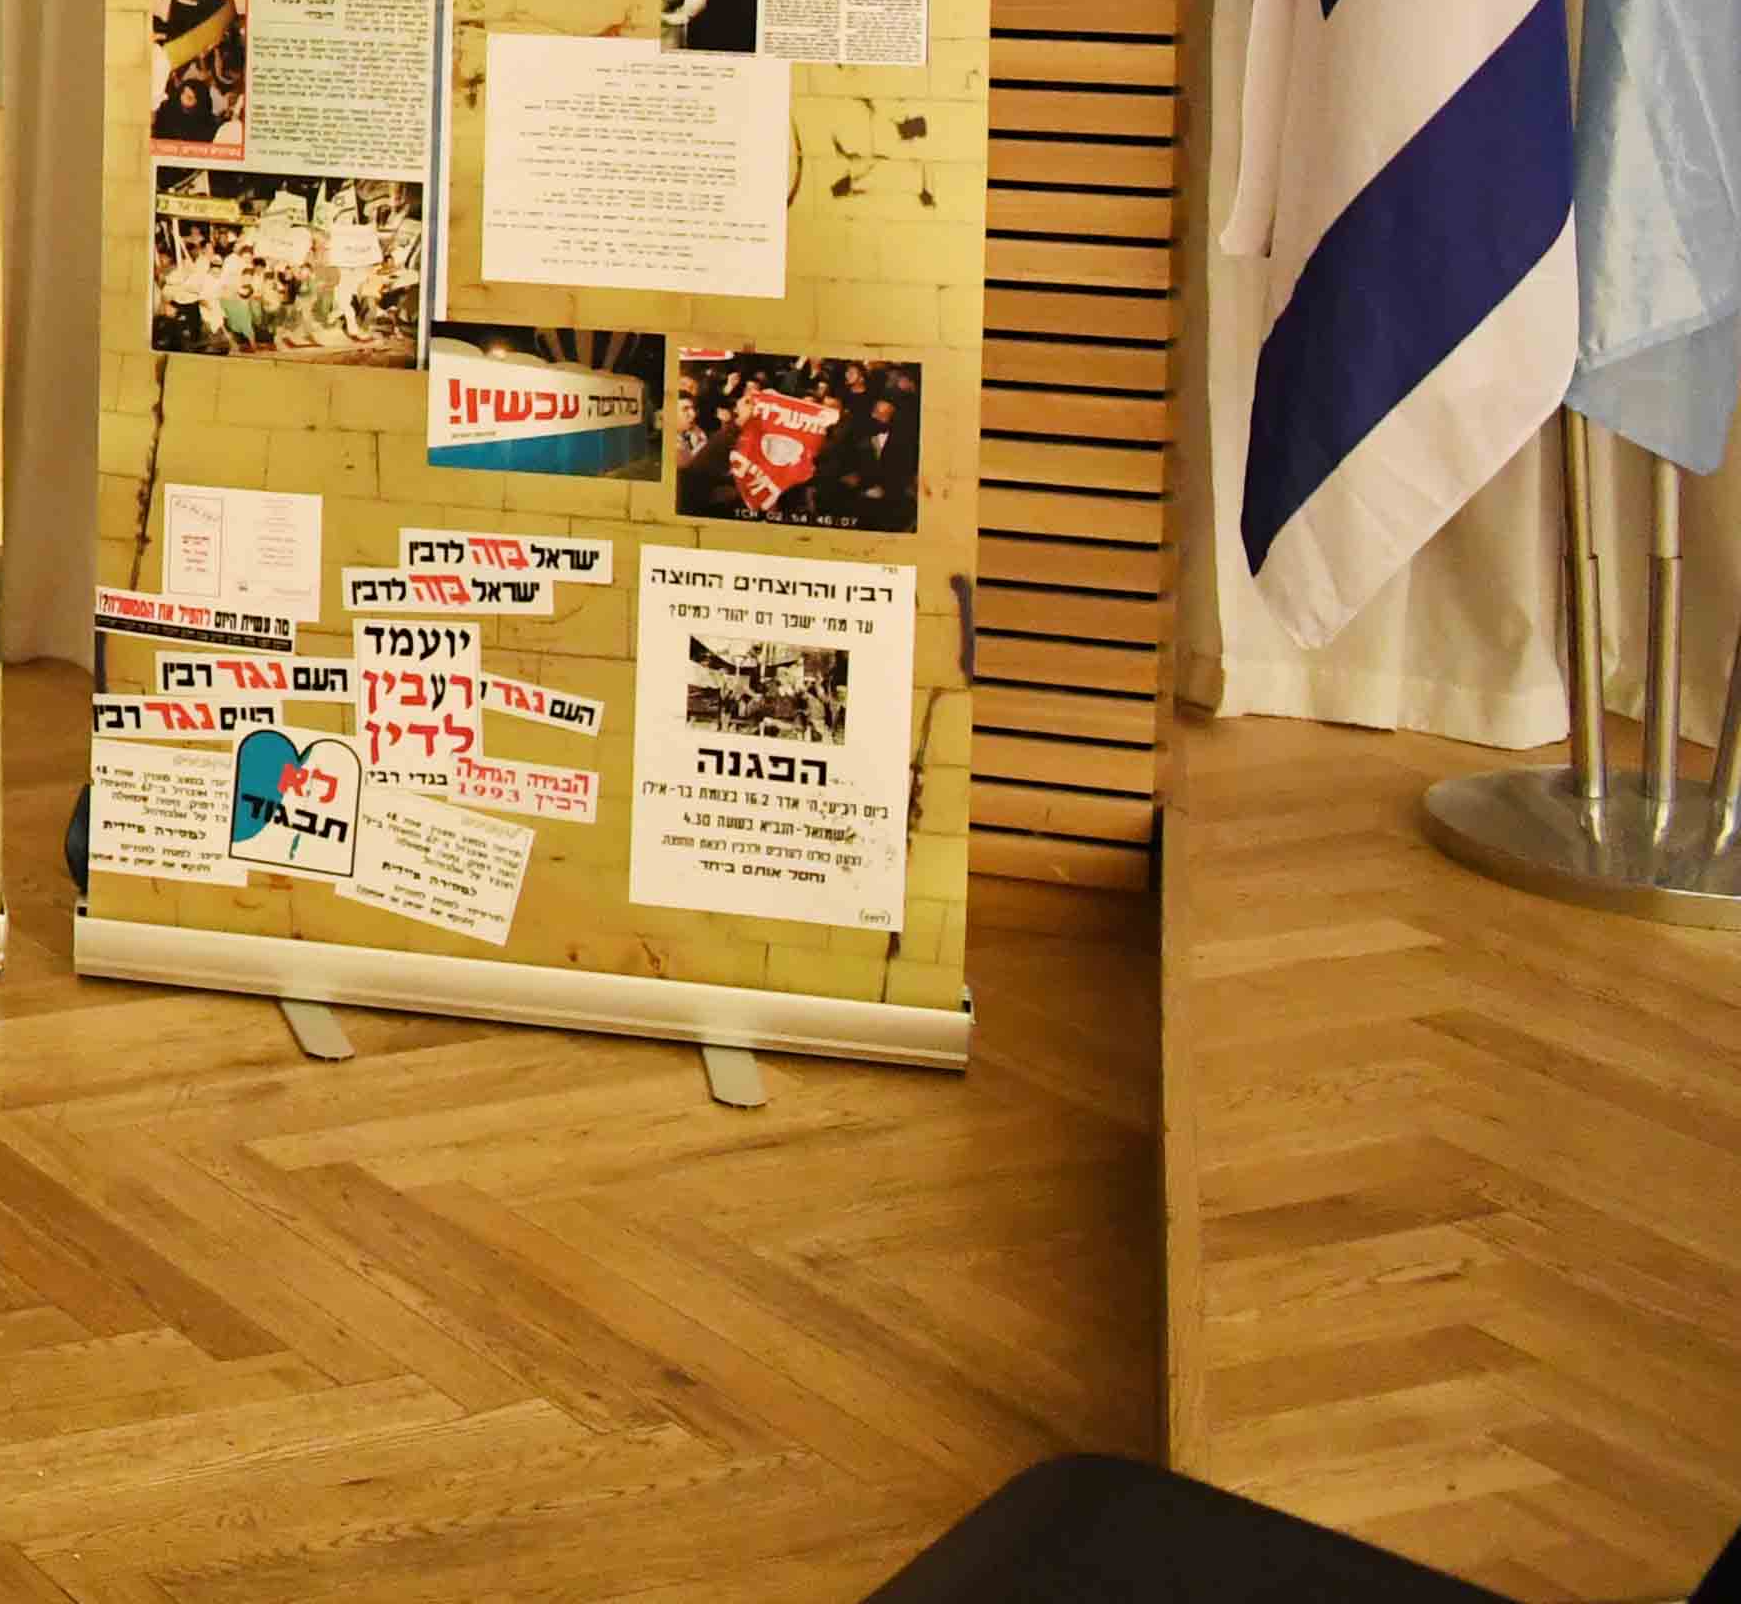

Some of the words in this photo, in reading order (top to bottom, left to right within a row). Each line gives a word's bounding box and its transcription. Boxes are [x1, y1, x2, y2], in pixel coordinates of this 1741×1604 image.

[447, 378, 579, 425] עכשיו!
[530, 543, 599, 570] ישראל
[471, 577, 540, 602] ישראל
[651, 568, 724, 588] החוצה
[734, 575, 835, 599] והרוצחים
[846, 585, 893, 603] רבין
[365, 626, 470, 660] יועמד
[162, 662, 212, 692] רבין
[217, 660, 288, 691] נגד
[293, 667, 349, 692] העם
[362, 669, 473, 713] רעבין
[492, 678, 546, 714] נגד
[144, 702, 217, 731] נגד
[548, 698, 595, 727] העם
[364, 713, 474, 764] לדין
[697, 748, 827, 786] הפגנה
[277, 762, 338, 803] לא
[241, 794, 348, 843] תבגוד
